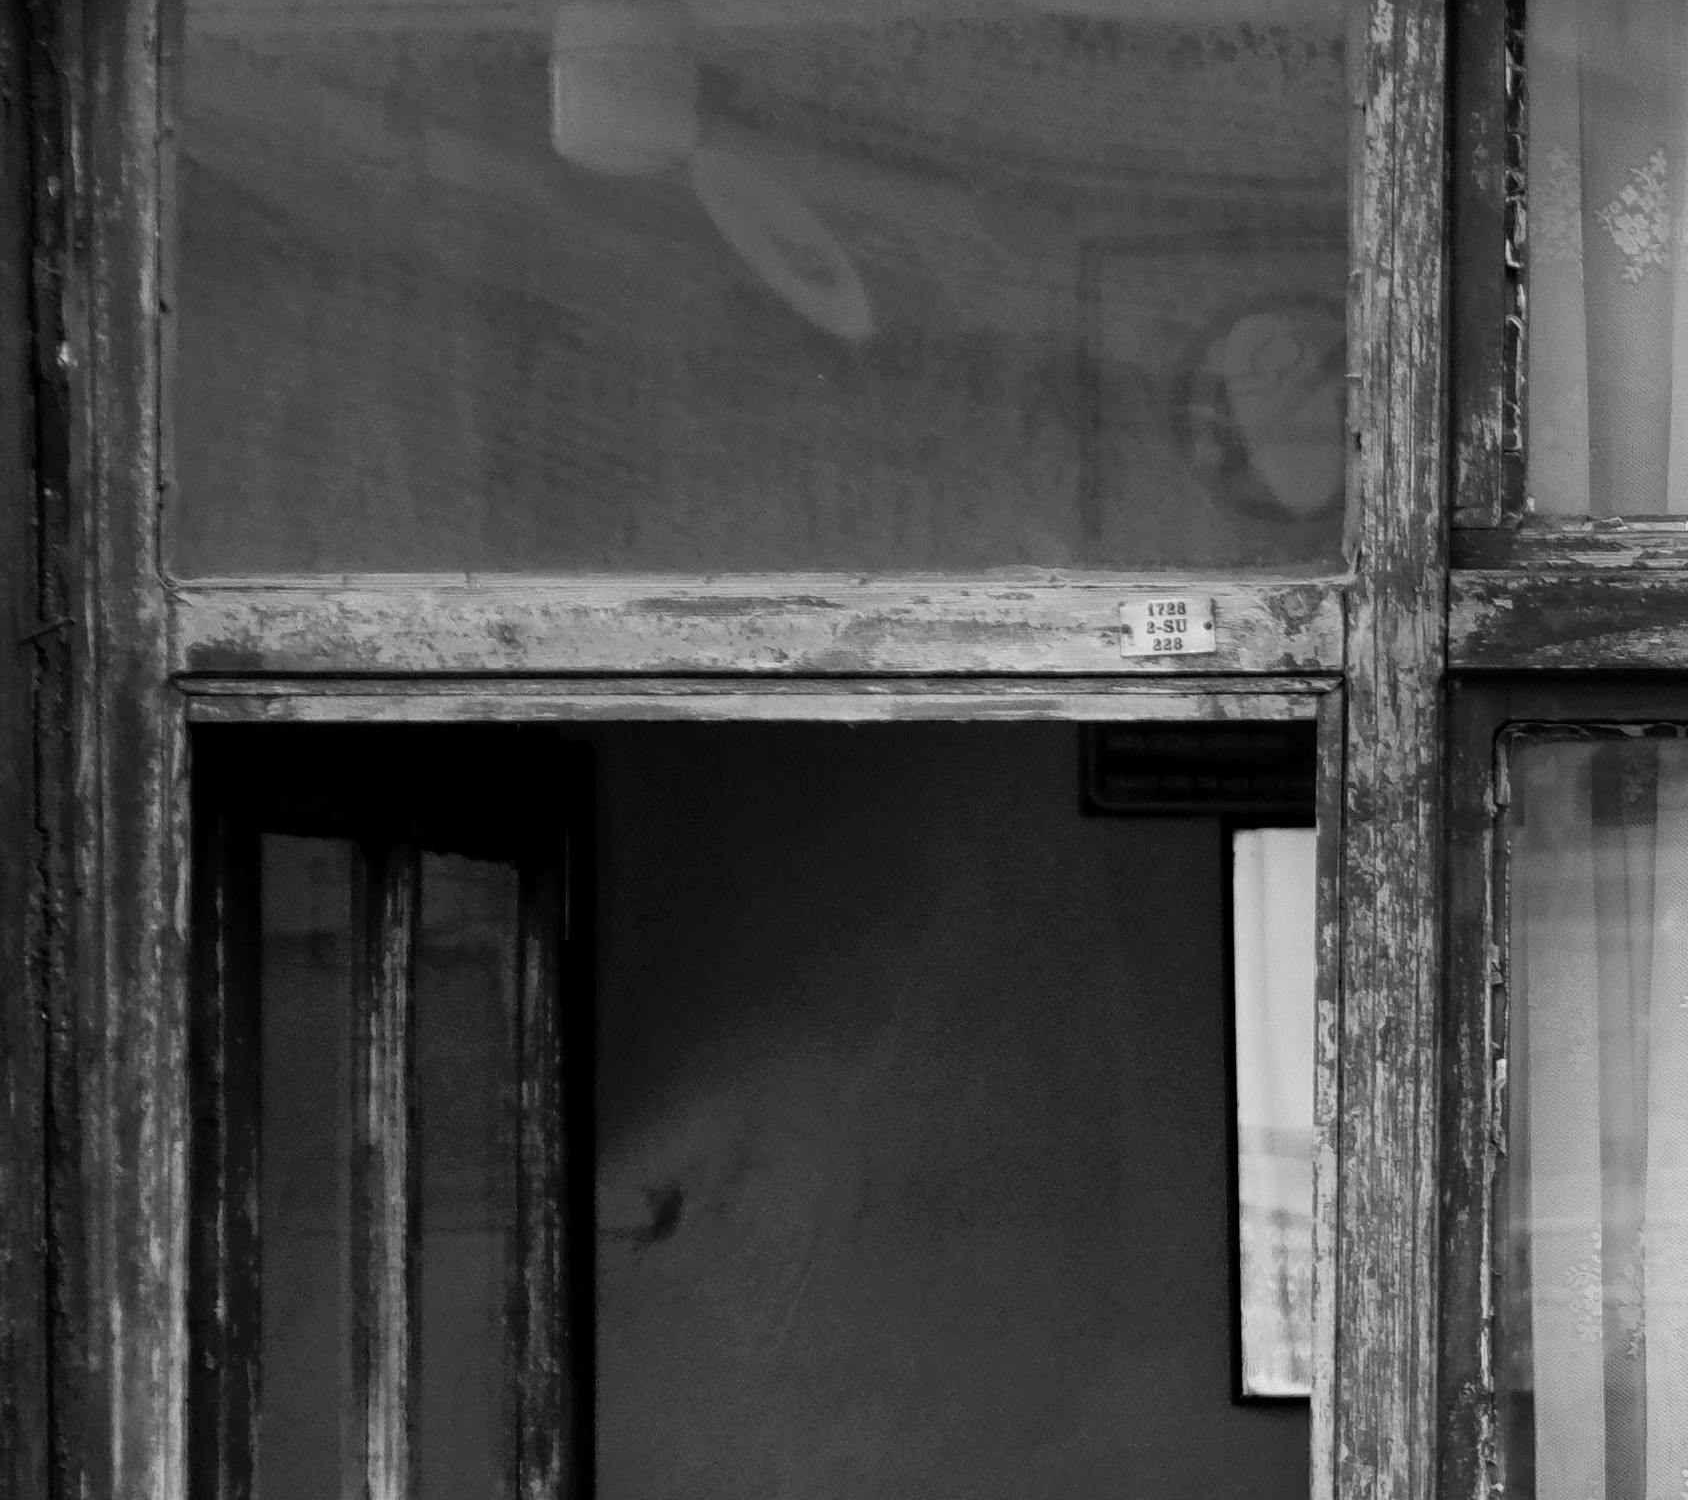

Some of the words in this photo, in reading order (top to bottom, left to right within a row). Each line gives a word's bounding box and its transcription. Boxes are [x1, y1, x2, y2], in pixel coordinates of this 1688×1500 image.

[1147, 602, 1186, 616] 1728
[1146, 619, 1187, 634] 2-SU
[1152, 637, 1183, 651] 228
